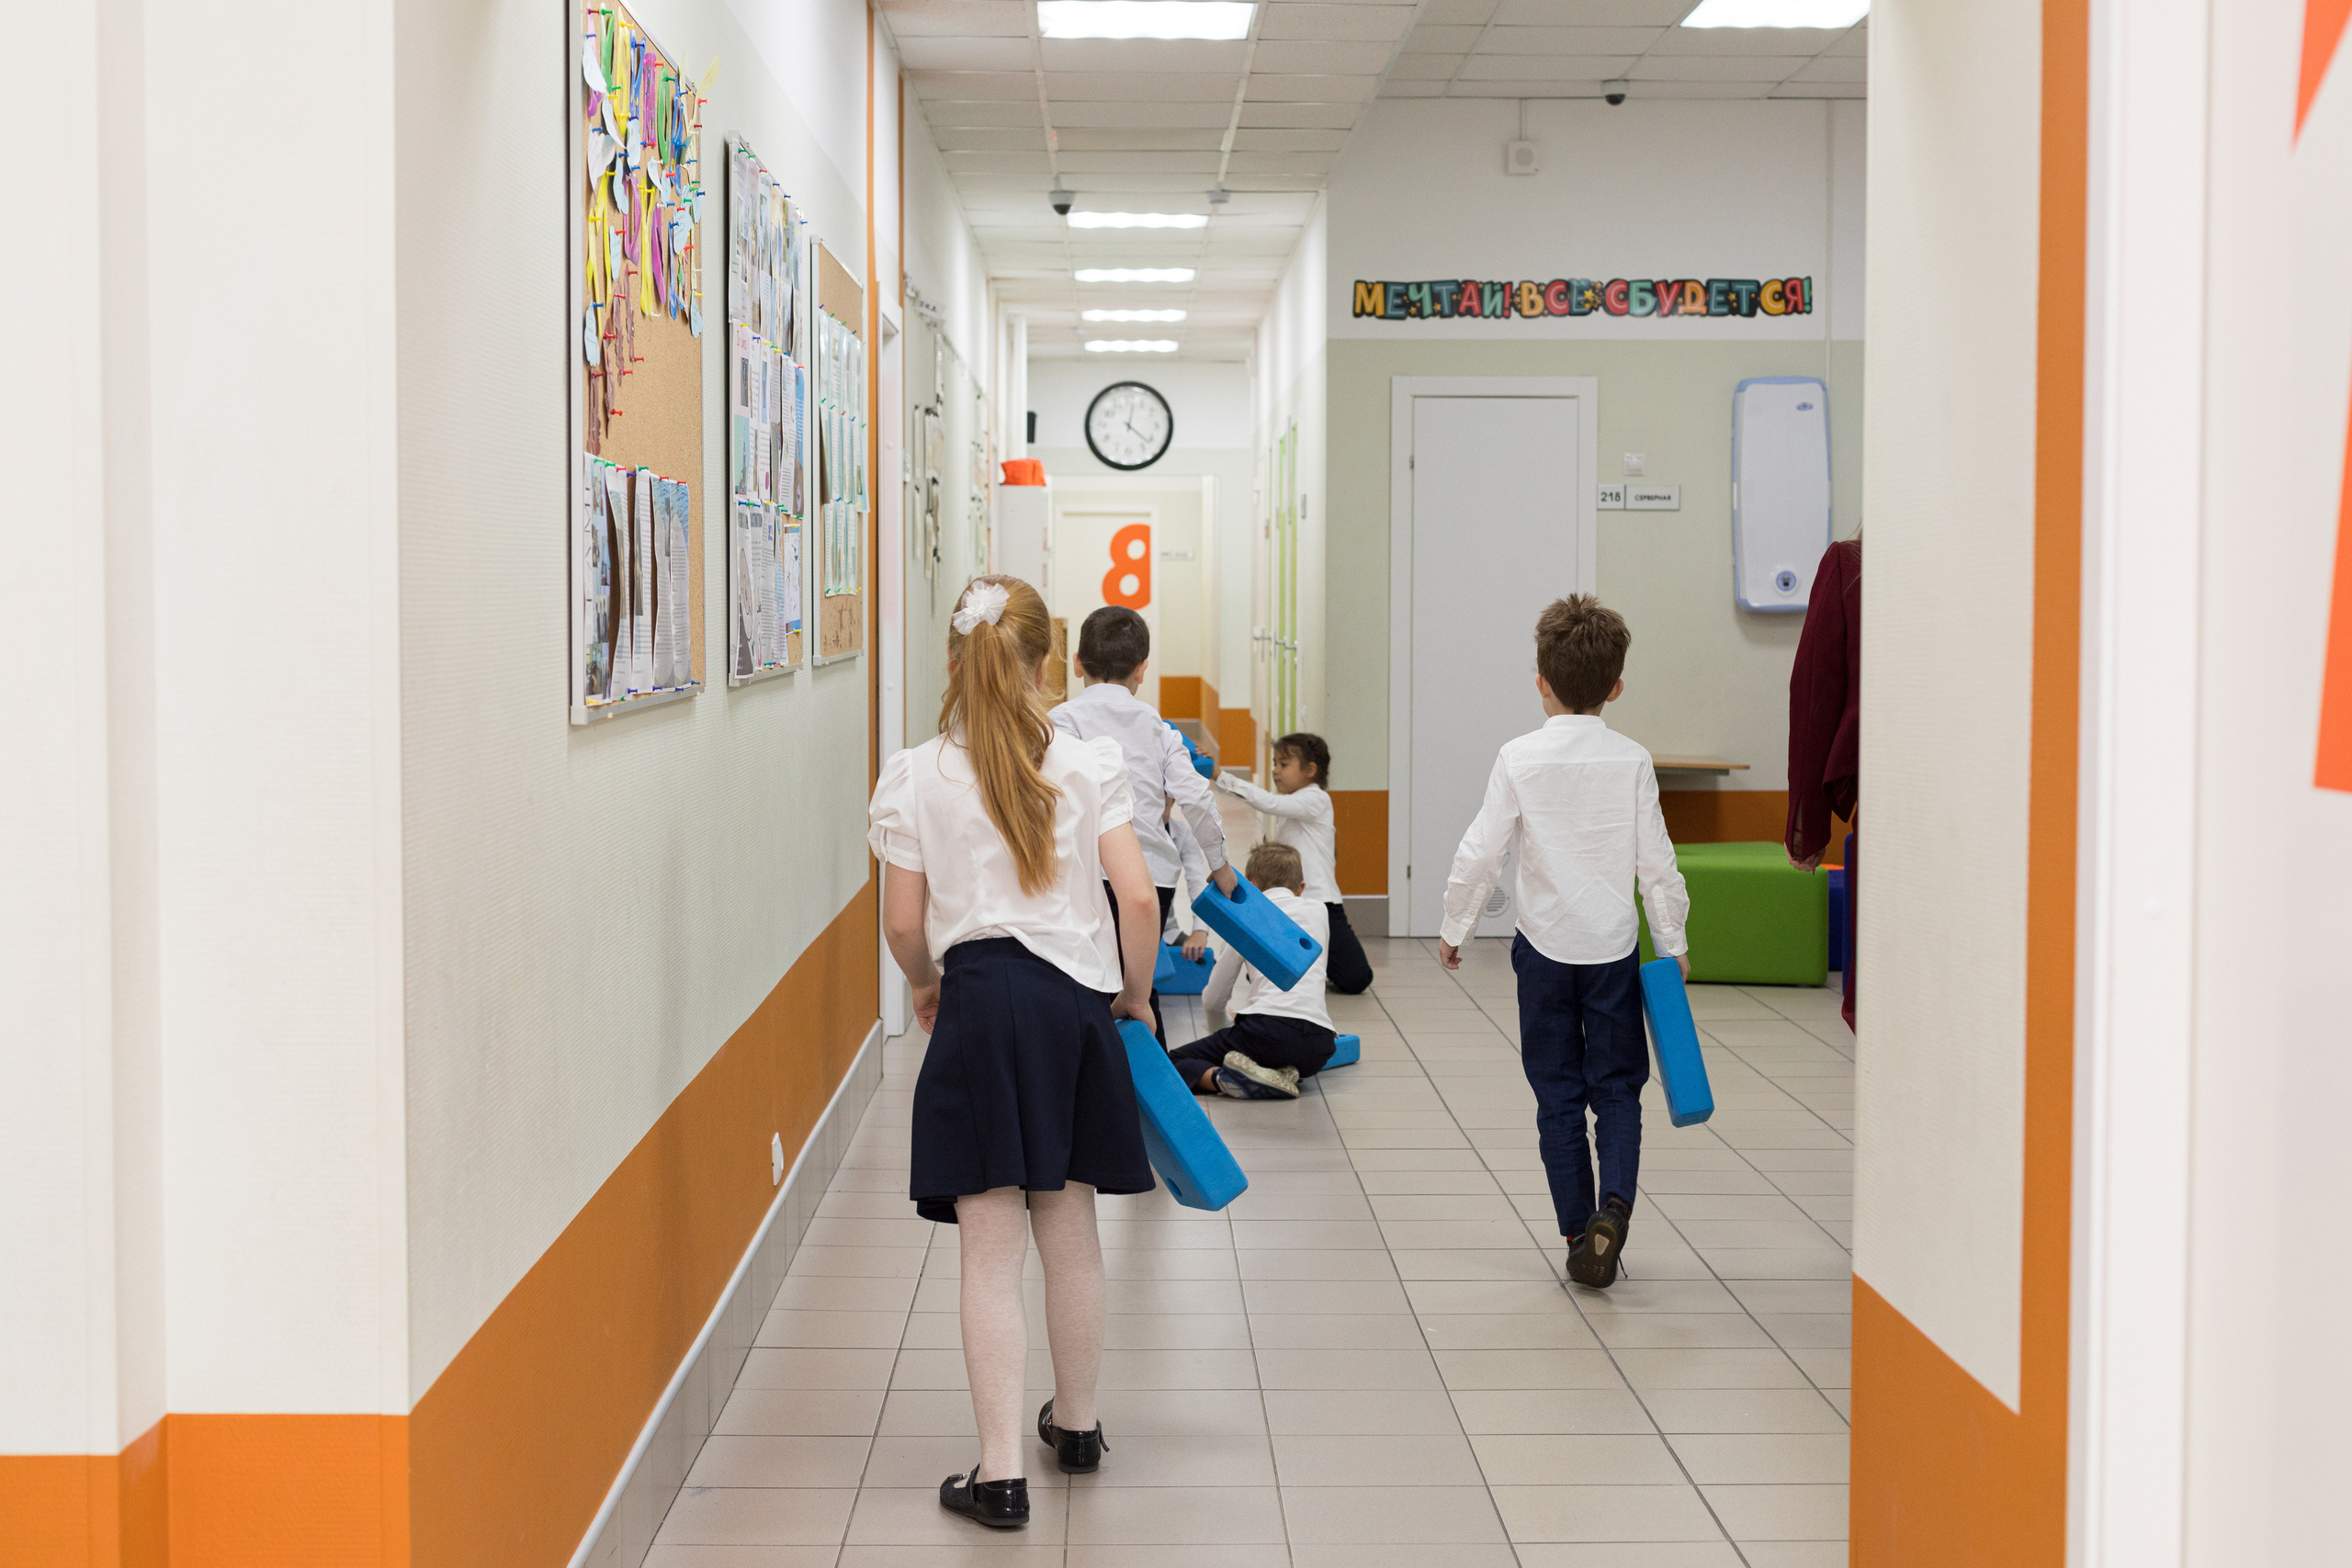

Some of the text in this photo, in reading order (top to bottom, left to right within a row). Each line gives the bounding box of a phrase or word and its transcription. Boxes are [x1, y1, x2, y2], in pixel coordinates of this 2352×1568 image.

[1353, 280, 1513, 319] МЕЧТАЙ!
[1604, 276, 1813, 318] СБУДЕТСЯ!
[1600, 491, 1622, 502] 218
